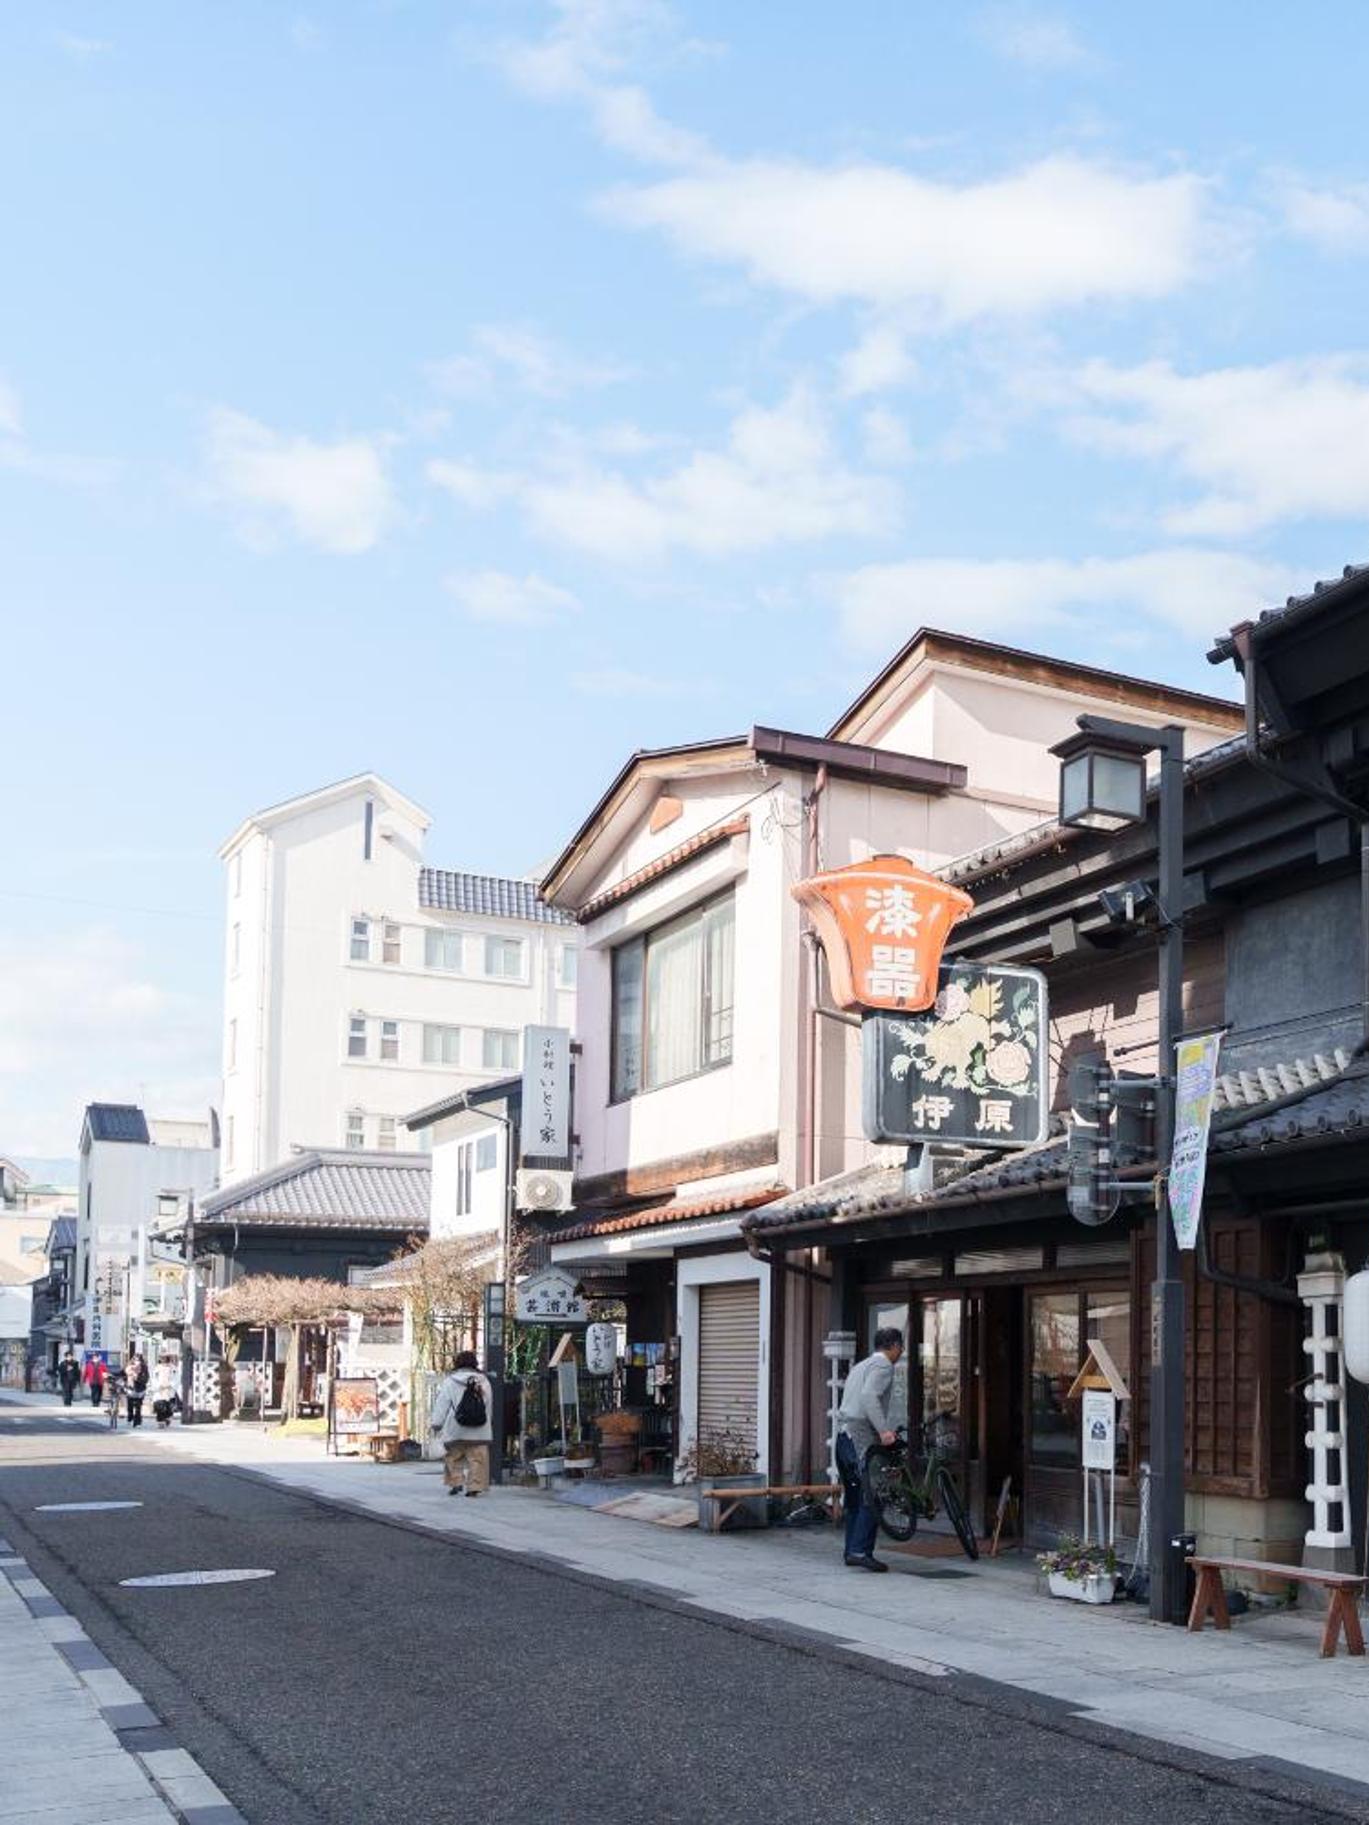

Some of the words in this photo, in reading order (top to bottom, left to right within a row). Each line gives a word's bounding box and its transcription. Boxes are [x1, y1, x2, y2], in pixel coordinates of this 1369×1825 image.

[863, 883, 923, 999] 漆器
[538, 1077, 559, 1145] いとう家
[911, 1093, 1015, 1133] 伊原
